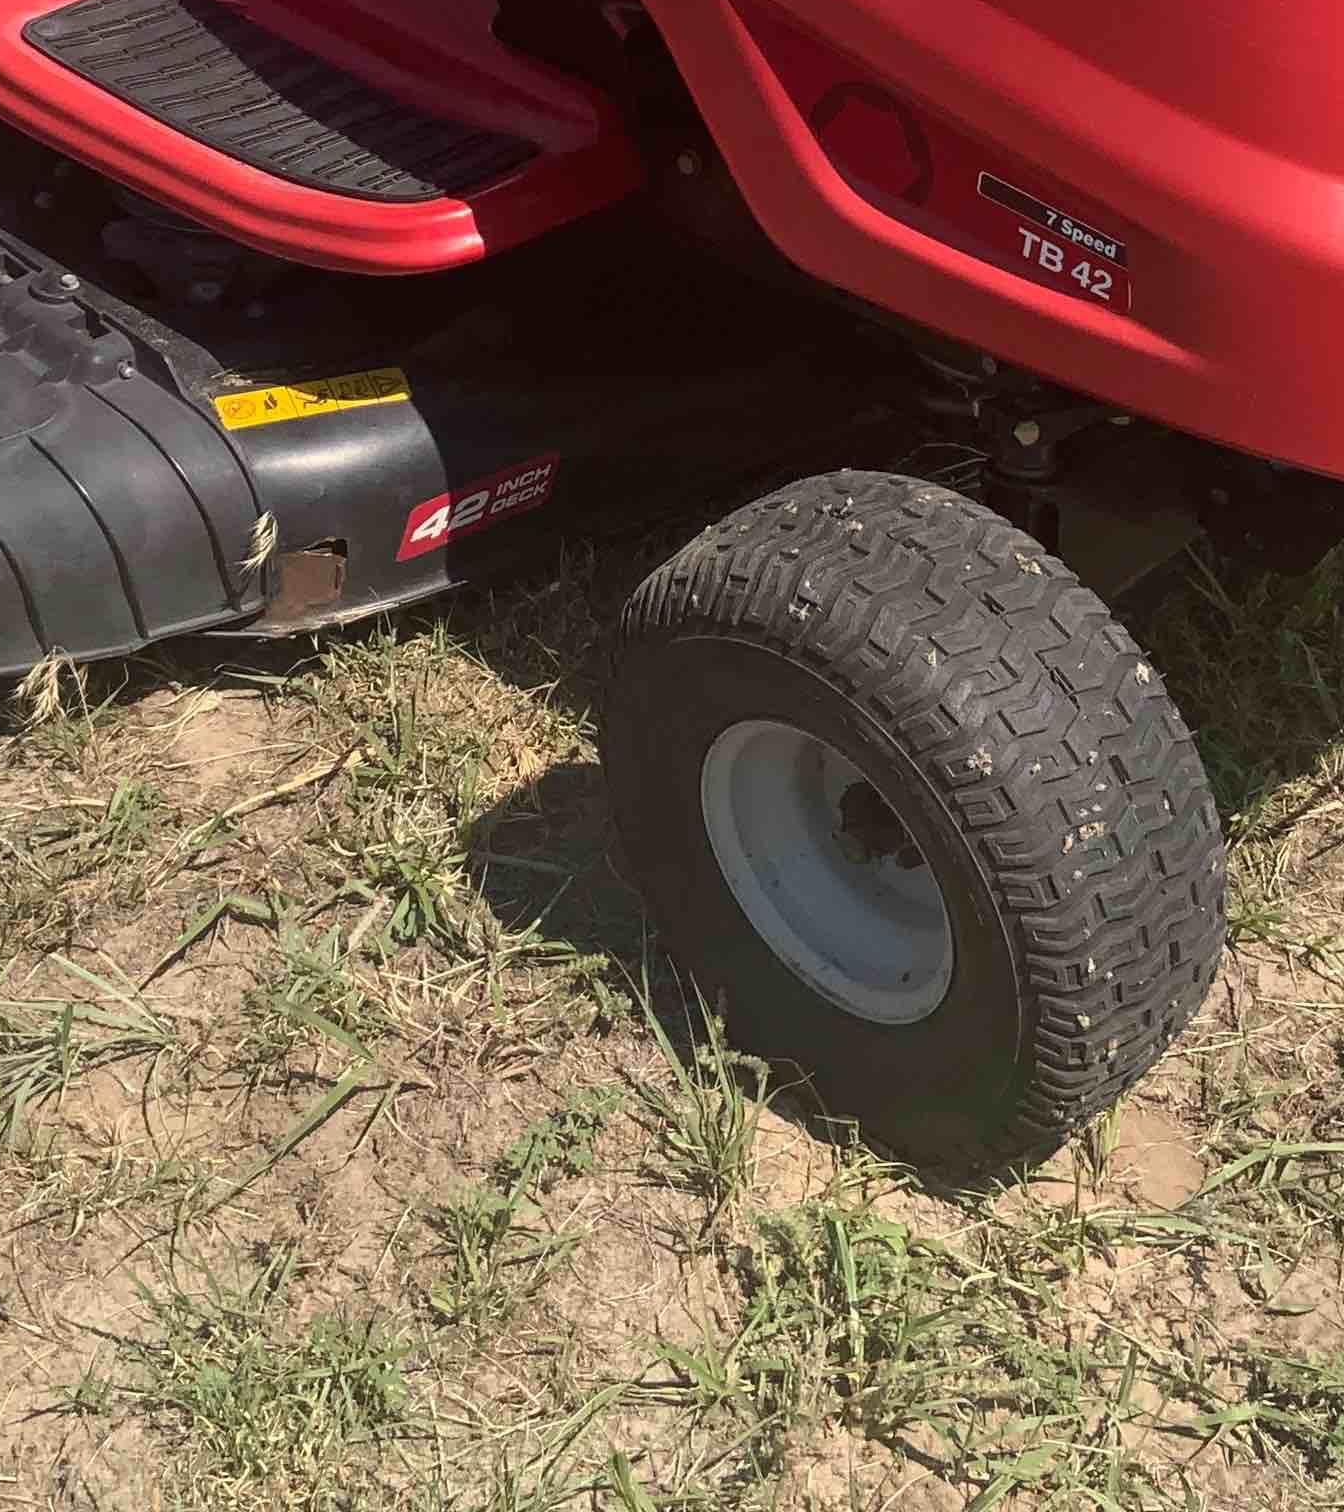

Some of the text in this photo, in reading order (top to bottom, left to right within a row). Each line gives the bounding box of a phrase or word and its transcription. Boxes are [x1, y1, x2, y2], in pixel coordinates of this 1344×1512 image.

[1045, 209, 1117, 259] 7 Speed
[1017, 225, 1114, 301] TB 42
[490, 481, 549, 515] DECK
[496, 463, 552, 497] INCH
[410, 490, 490, 543] 42
